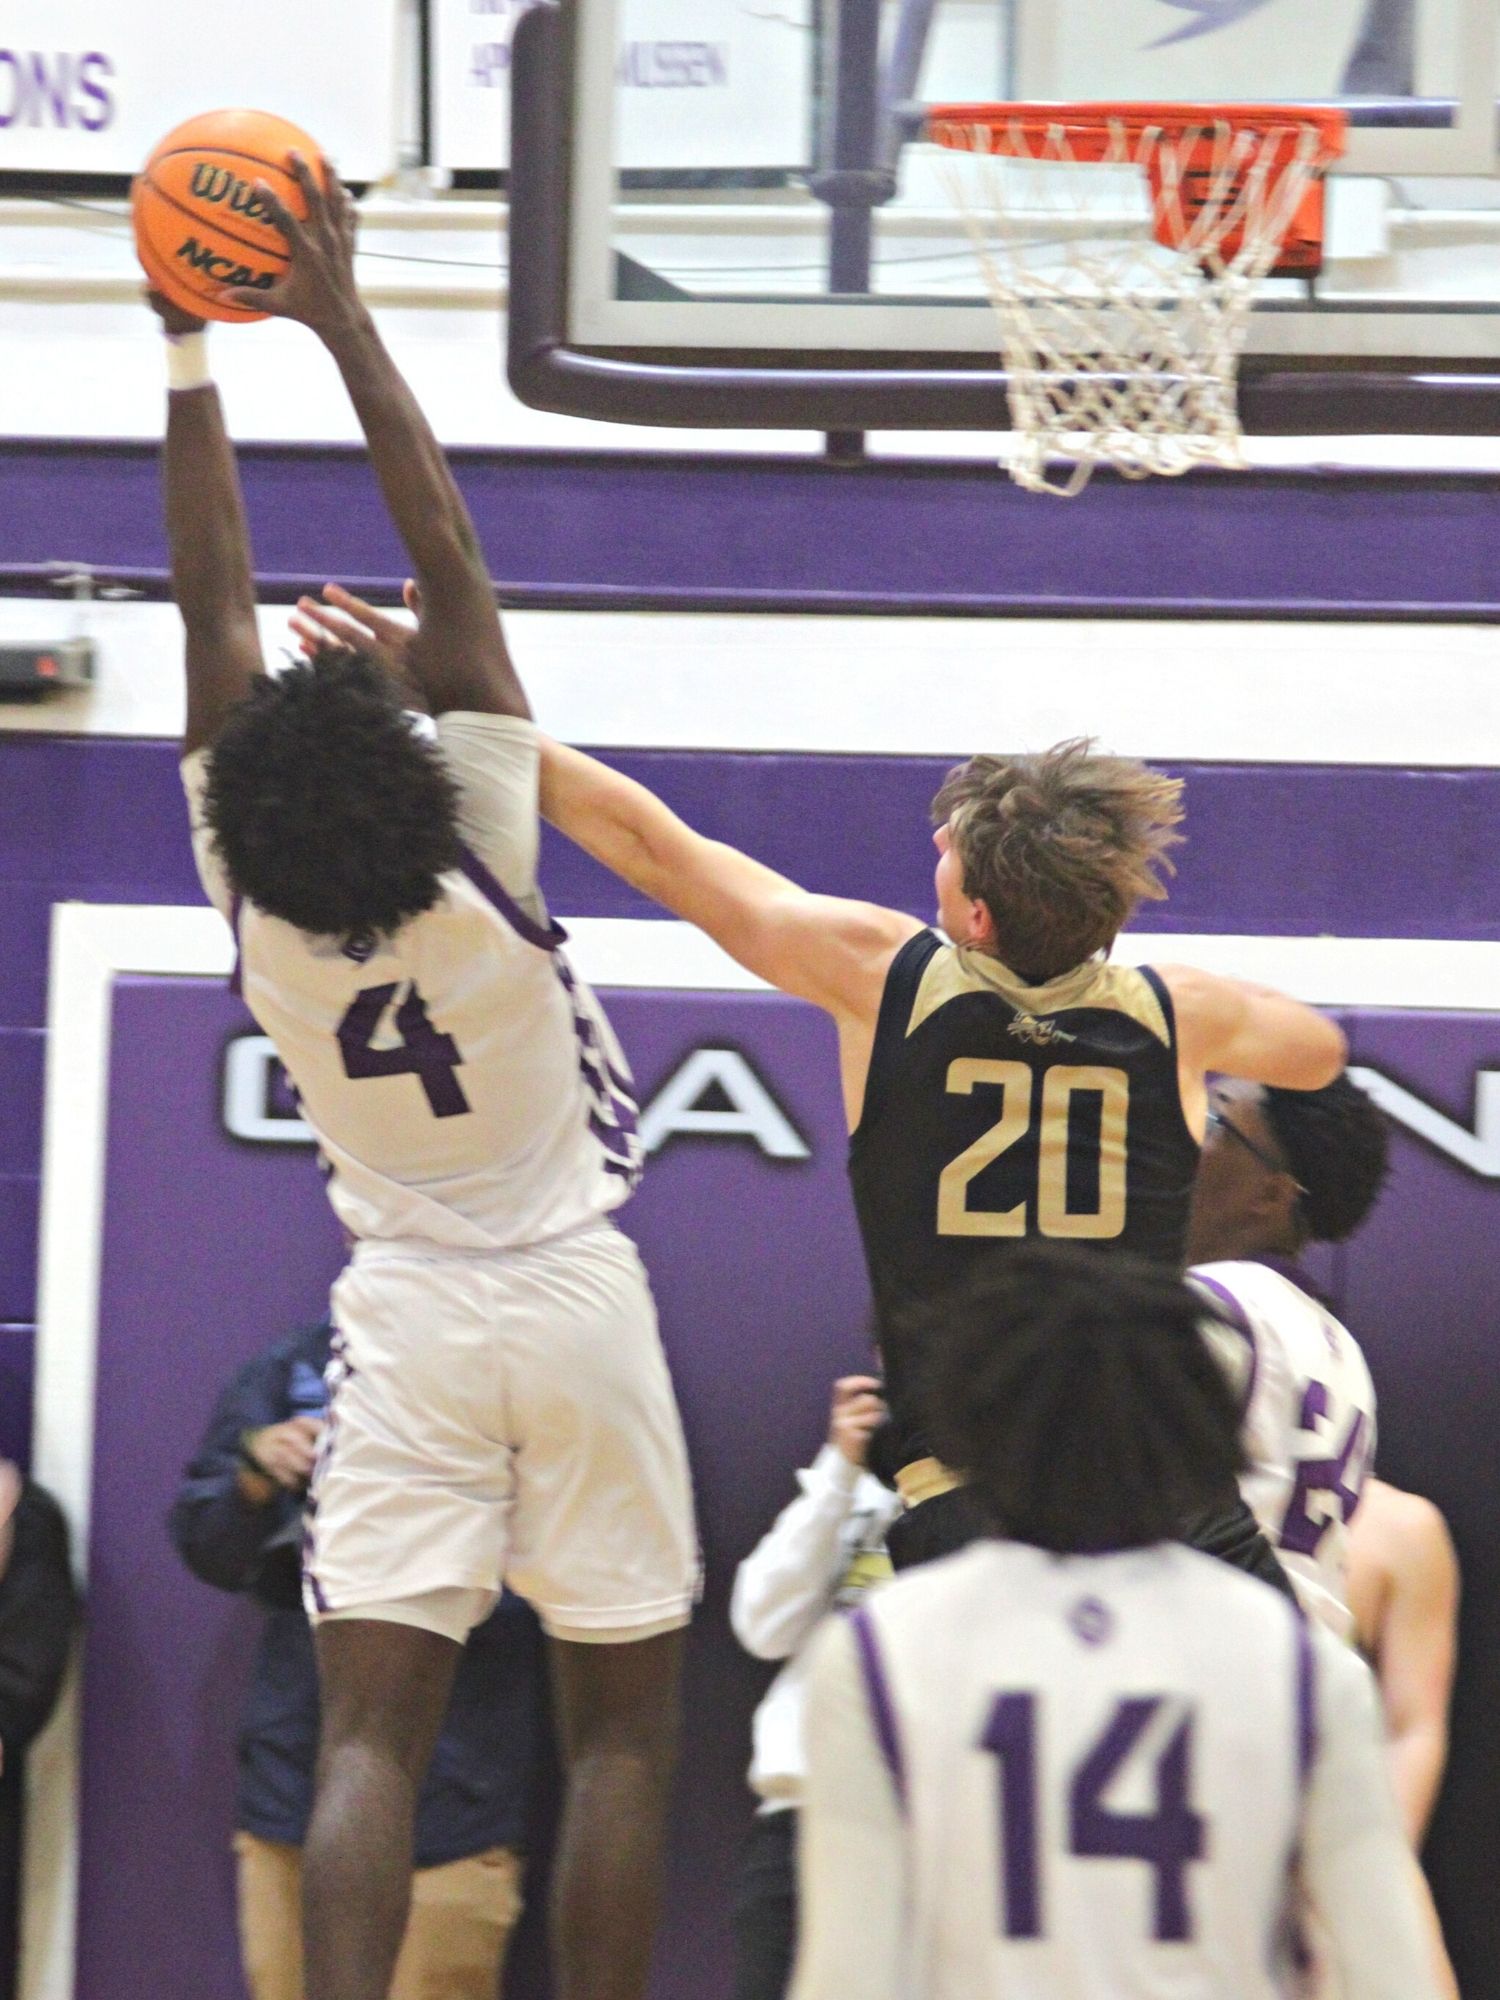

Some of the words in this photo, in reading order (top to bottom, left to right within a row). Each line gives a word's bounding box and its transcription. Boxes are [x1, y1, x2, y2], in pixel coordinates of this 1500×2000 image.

[177, 237, 277, 290] NCAA
[335, 977, 473, 1119] 4
[936, 1056, 1129, 1239] 20
[974, 1688, 1211, 1943] 14
